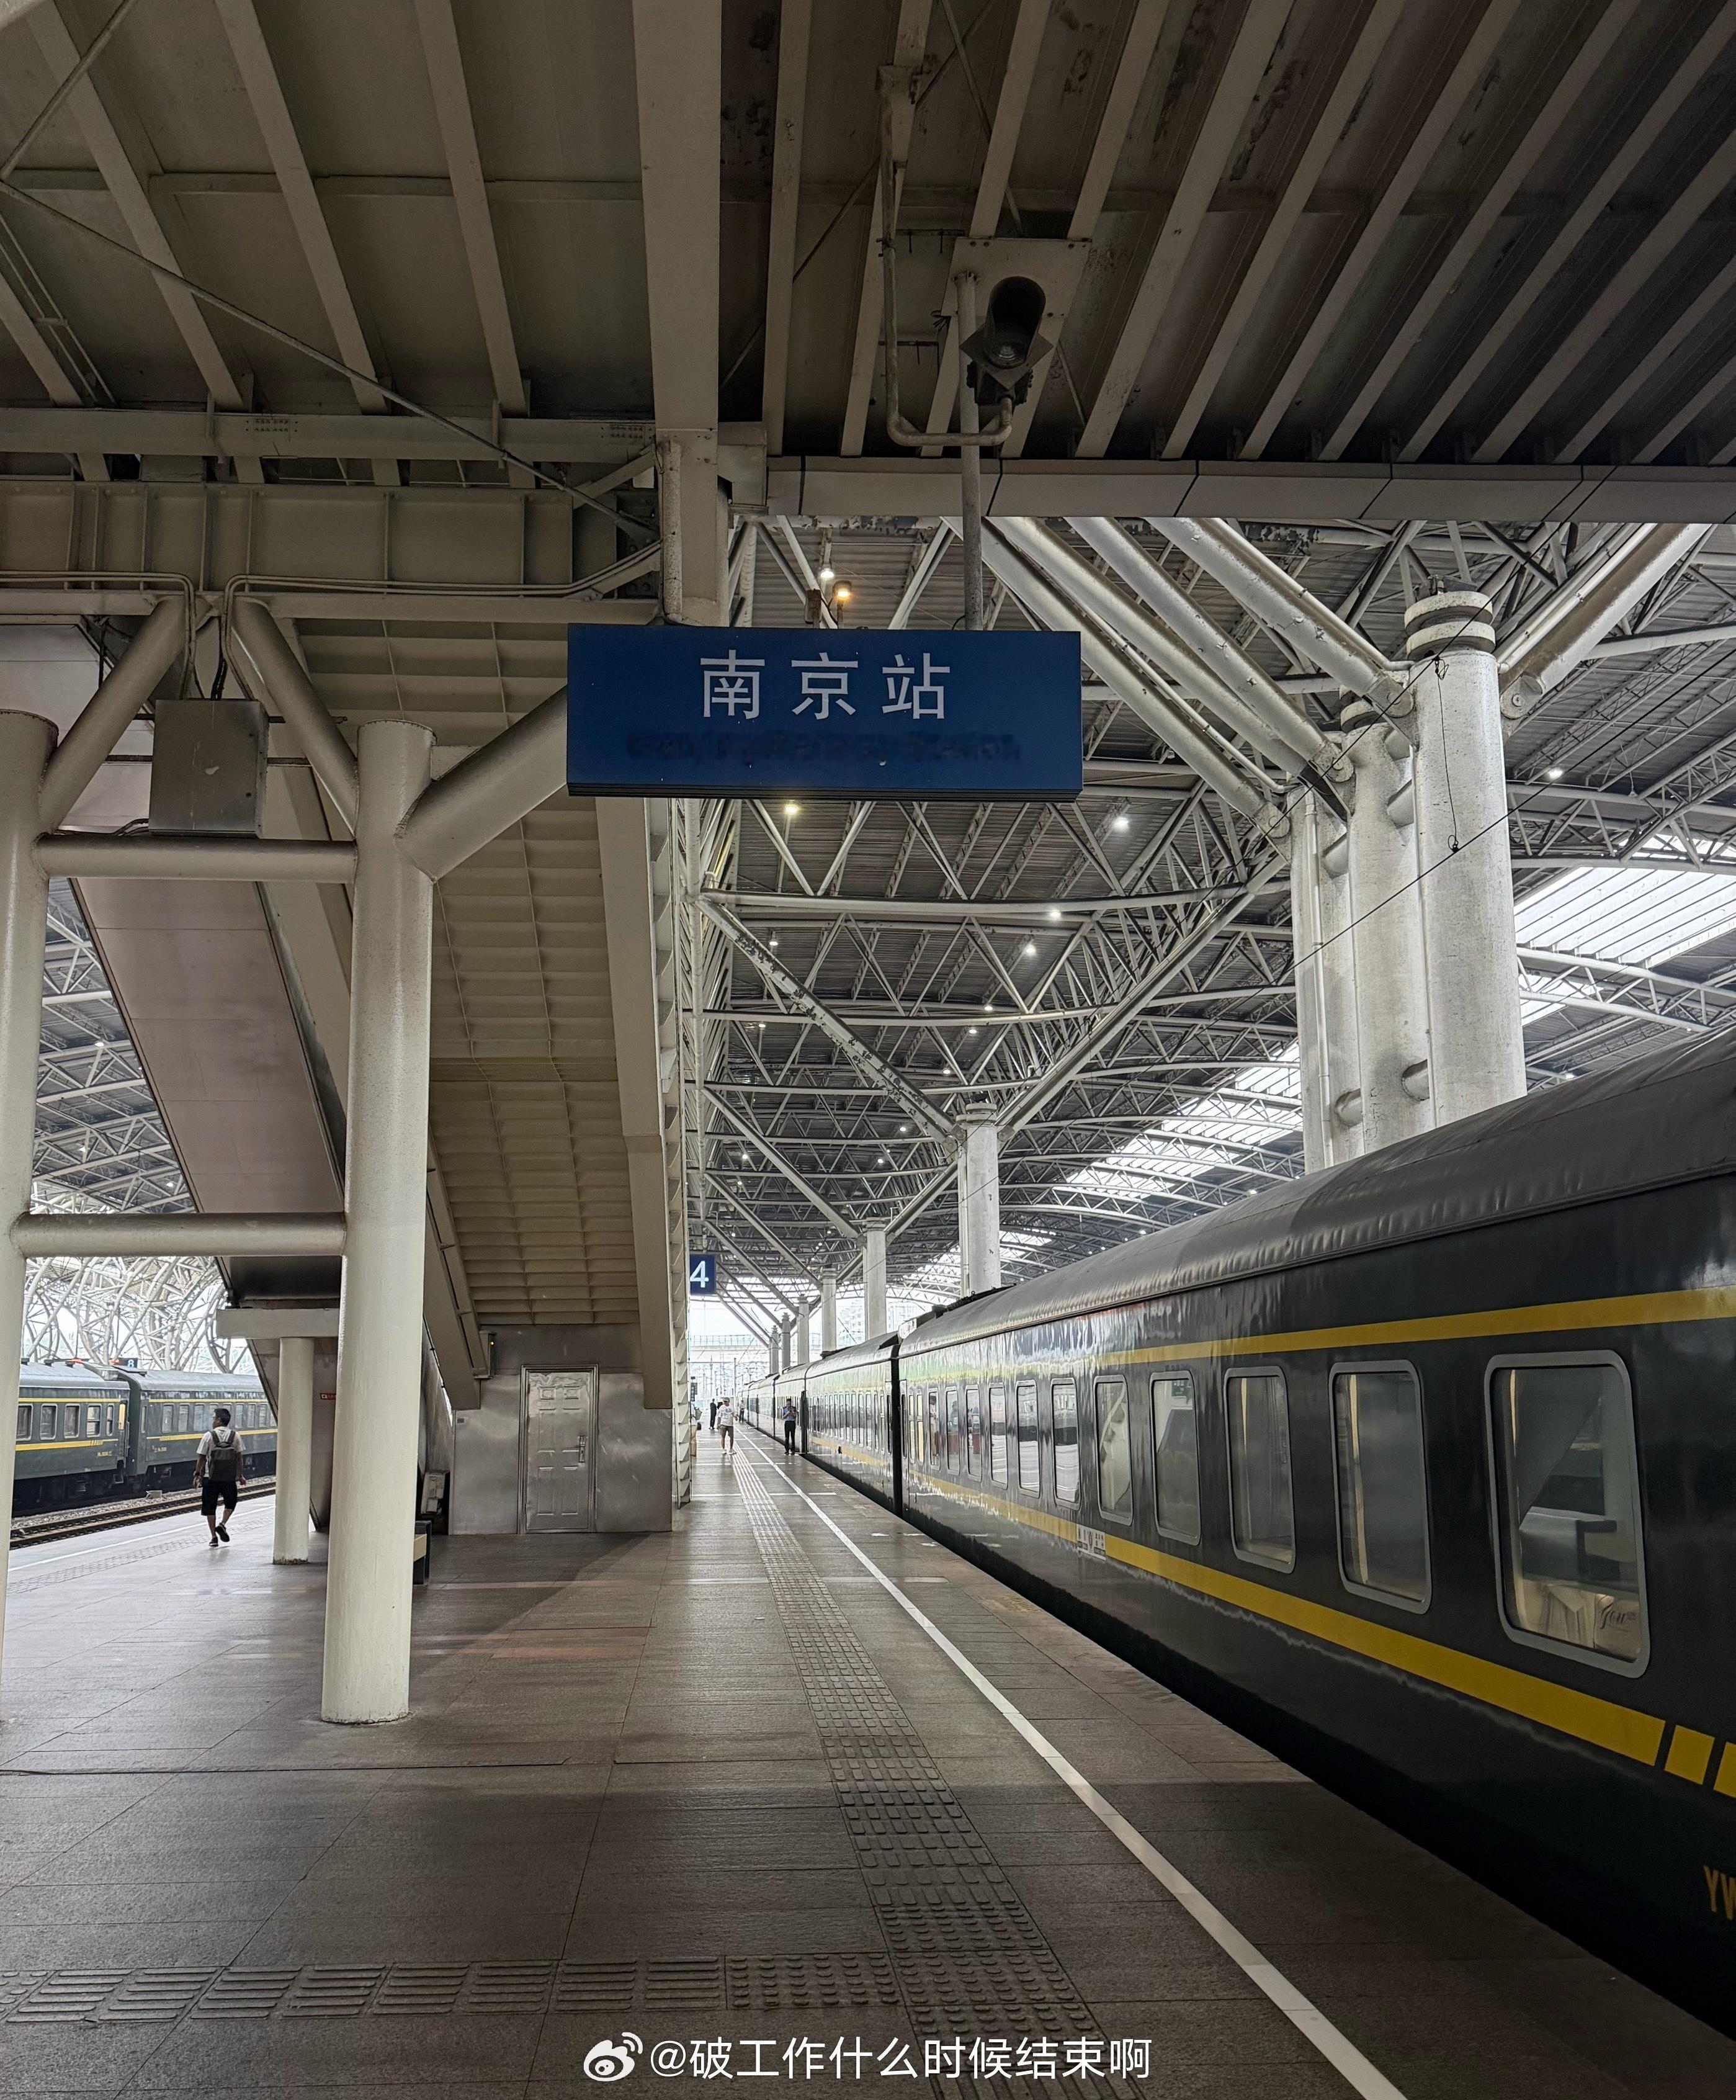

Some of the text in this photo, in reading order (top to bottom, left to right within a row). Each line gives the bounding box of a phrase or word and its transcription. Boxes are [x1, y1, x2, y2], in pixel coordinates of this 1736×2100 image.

[700, 649, 951, 720] 南京站
[689, 1260, 709, 1288] 4
[127, 1359, 135, 1368] 8
